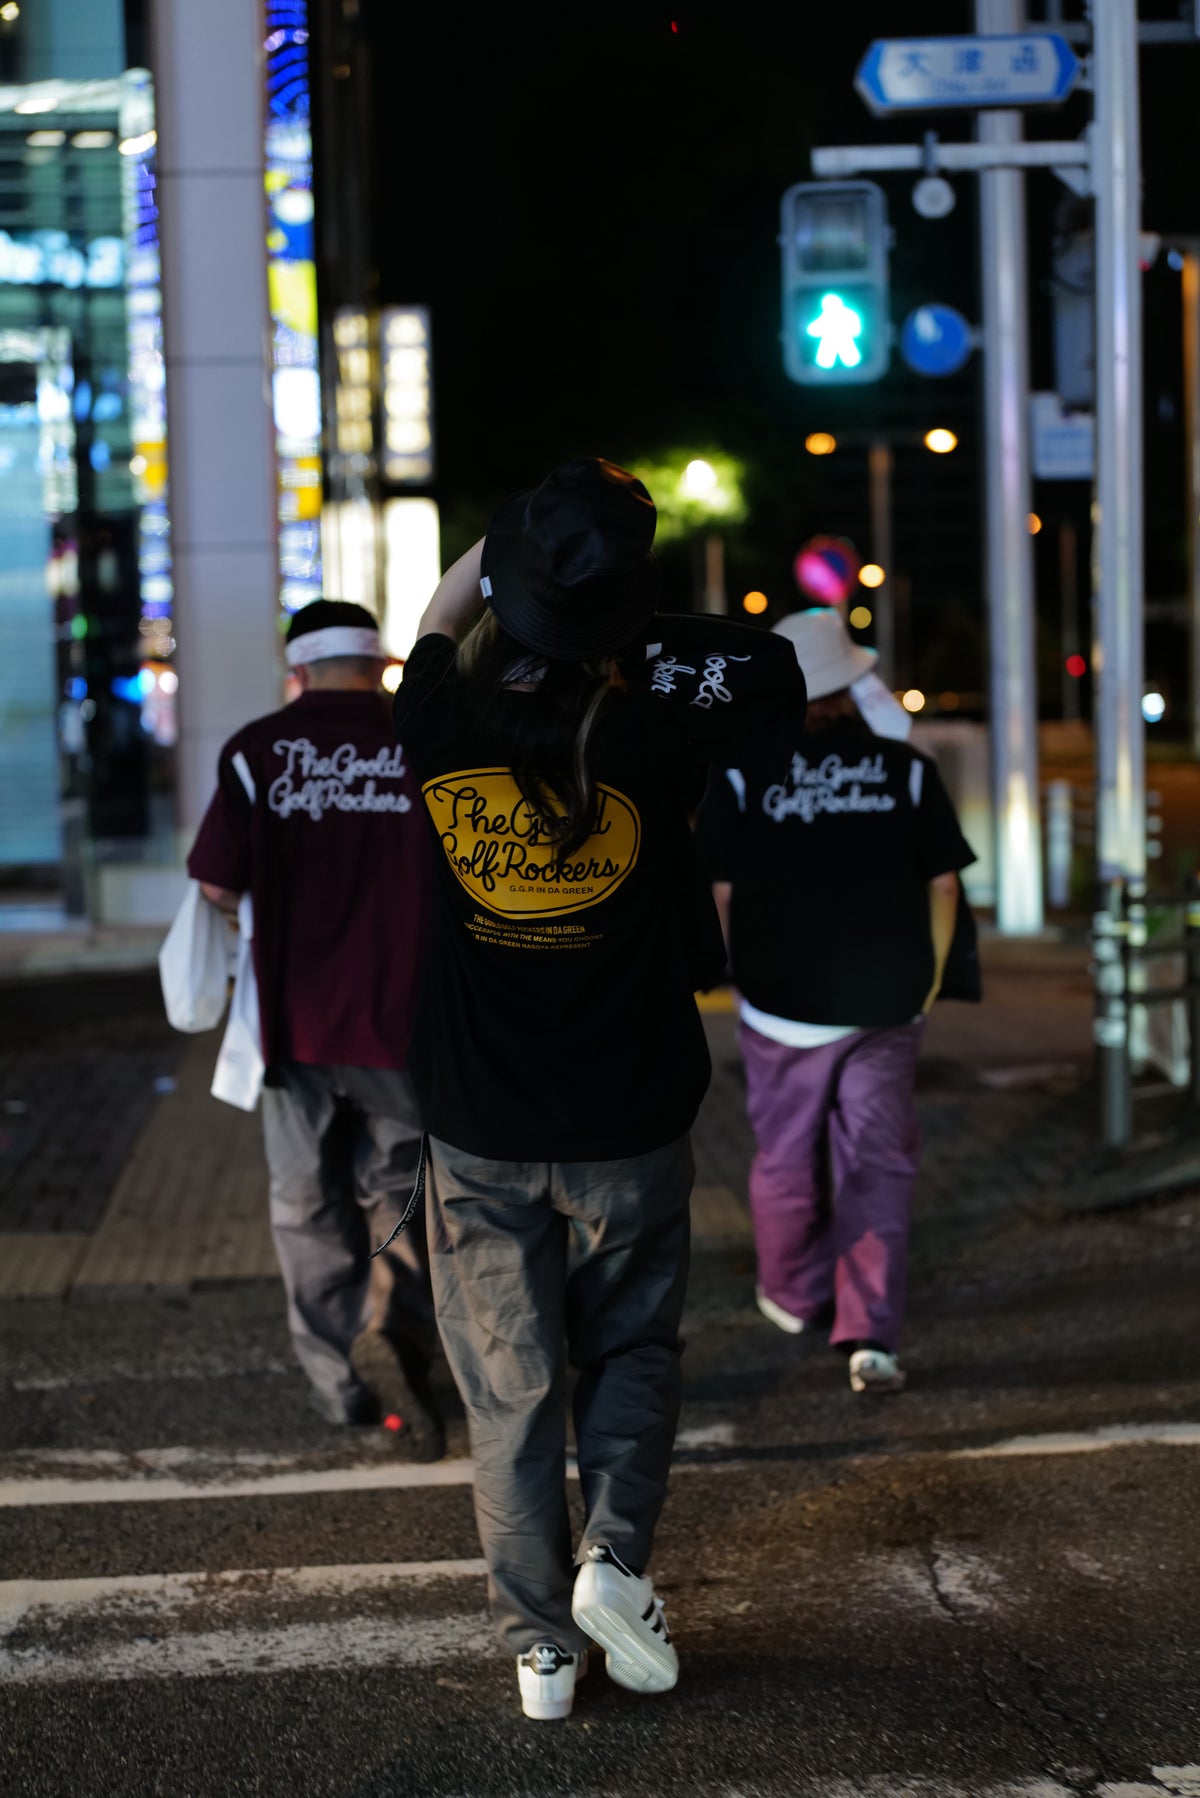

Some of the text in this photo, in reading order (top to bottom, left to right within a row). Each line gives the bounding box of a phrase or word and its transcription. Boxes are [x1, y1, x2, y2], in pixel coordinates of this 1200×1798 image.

[496, 841, 619, 883] Rockers
[547, 887, 560, 895] DA
[562, 886, 594, 896] GREEN
